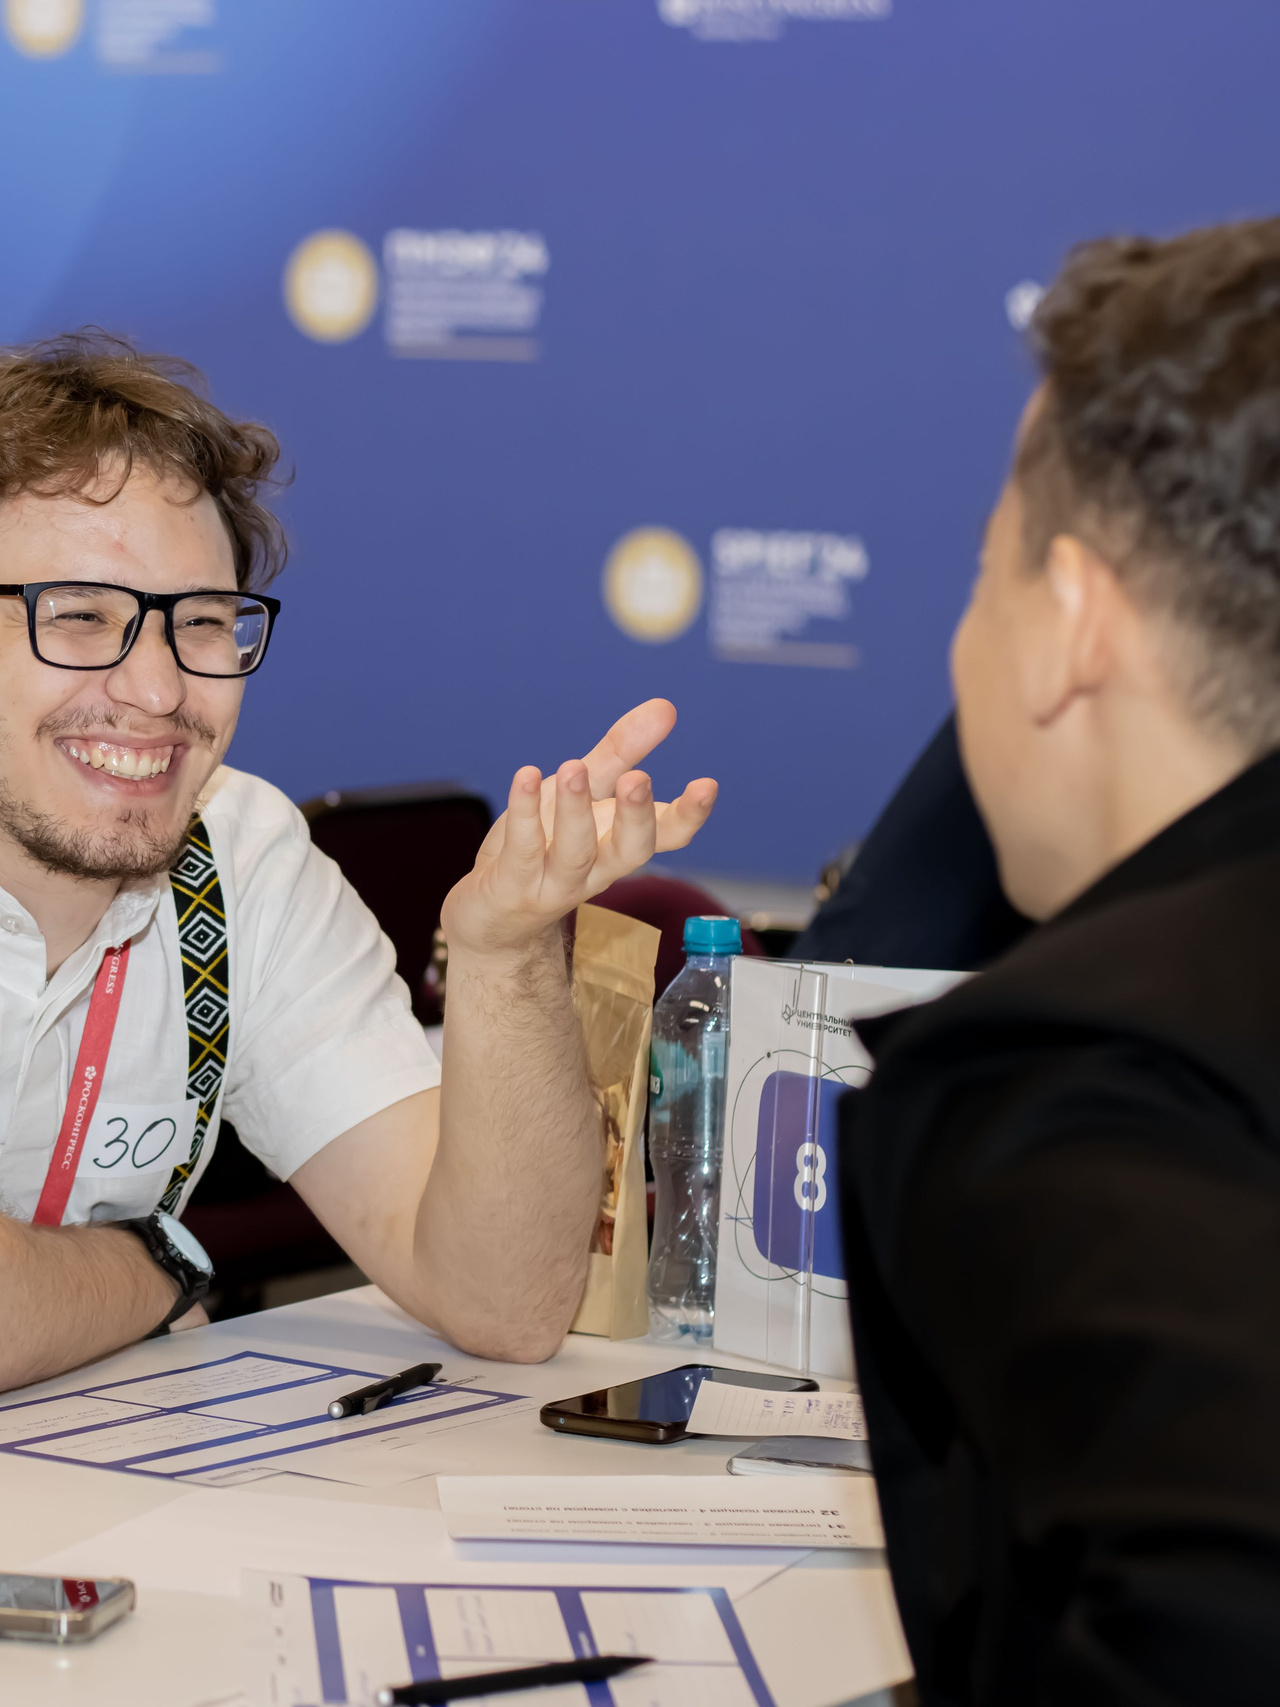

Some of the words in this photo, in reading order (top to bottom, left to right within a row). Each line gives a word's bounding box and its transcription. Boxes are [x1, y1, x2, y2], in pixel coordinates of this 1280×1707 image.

[60, 1080, 94, 1171] РОСКОНГРЕСС
[92, 1116, 177, 1169] 30
[793, 1142, 827, 1213] 8
